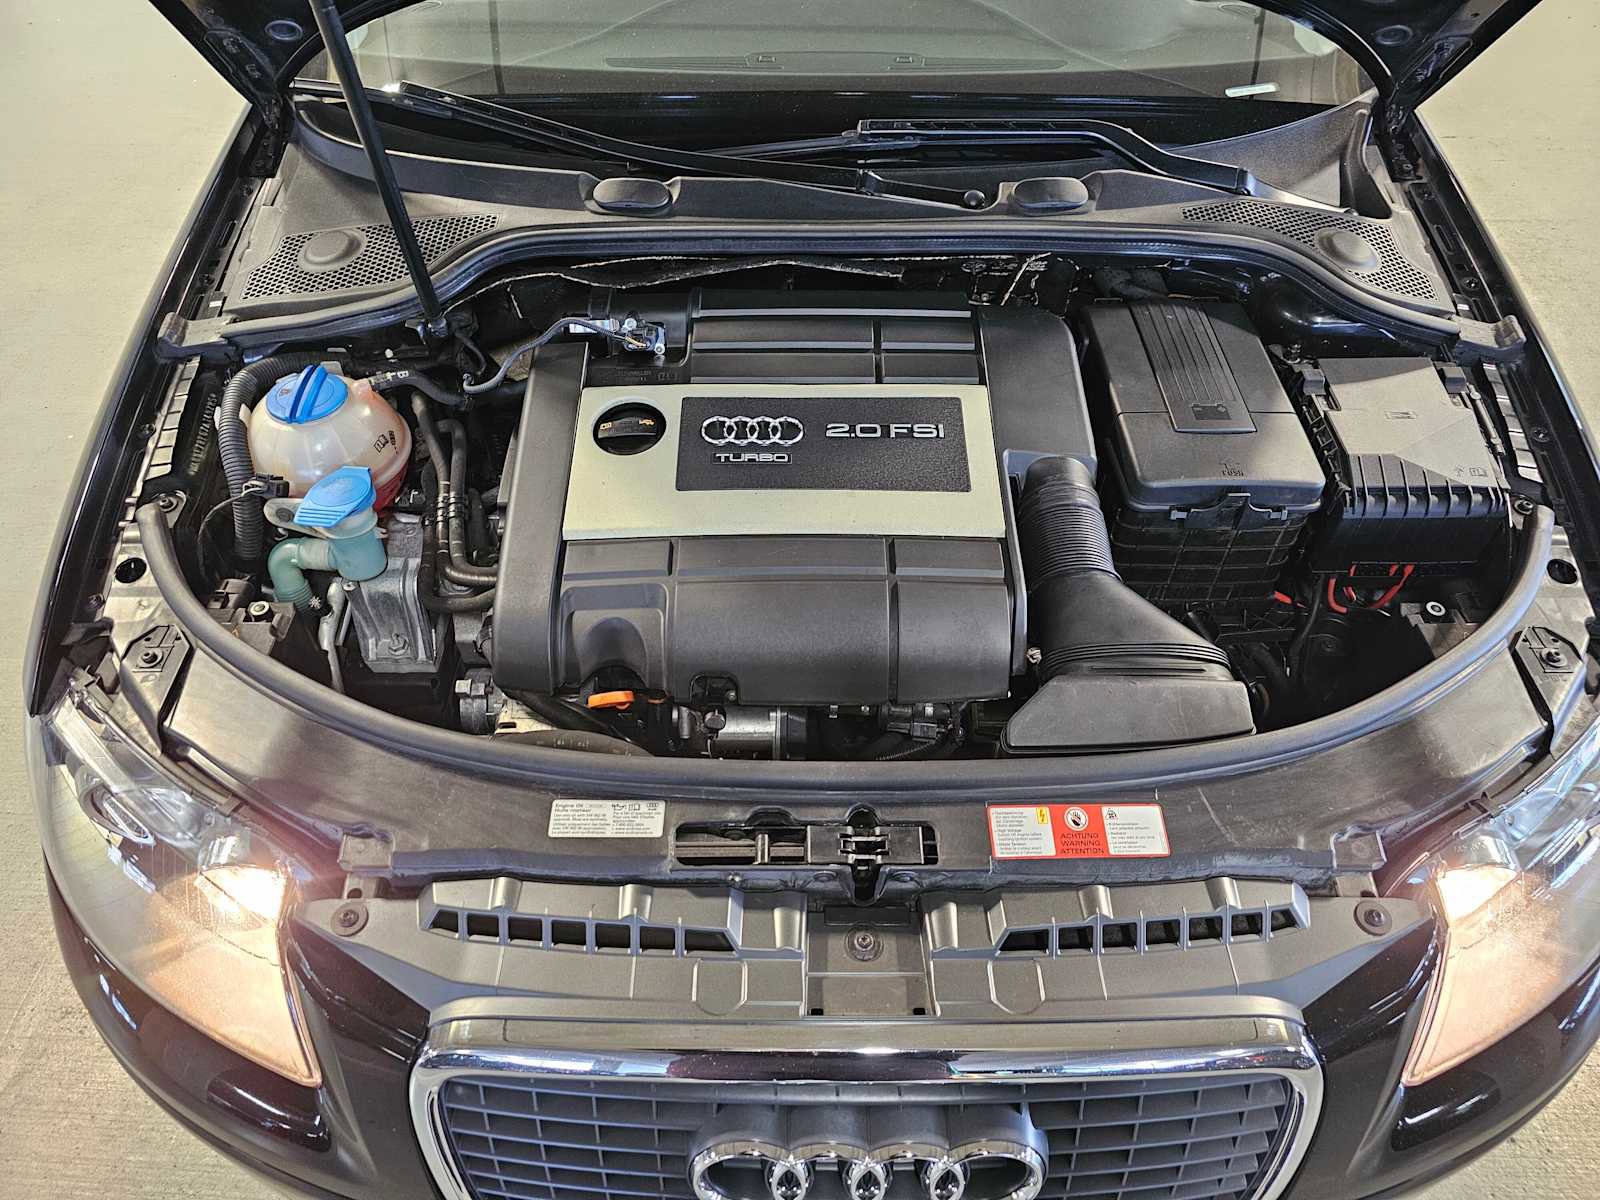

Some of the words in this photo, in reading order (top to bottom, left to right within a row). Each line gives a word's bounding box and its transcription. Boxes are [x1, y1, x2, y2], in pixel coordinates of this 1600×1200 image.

[825, 423, 881, 439] 2.0
[889, 424, 945, 439] FSI
[715, 453, 789, 463] TURBO
